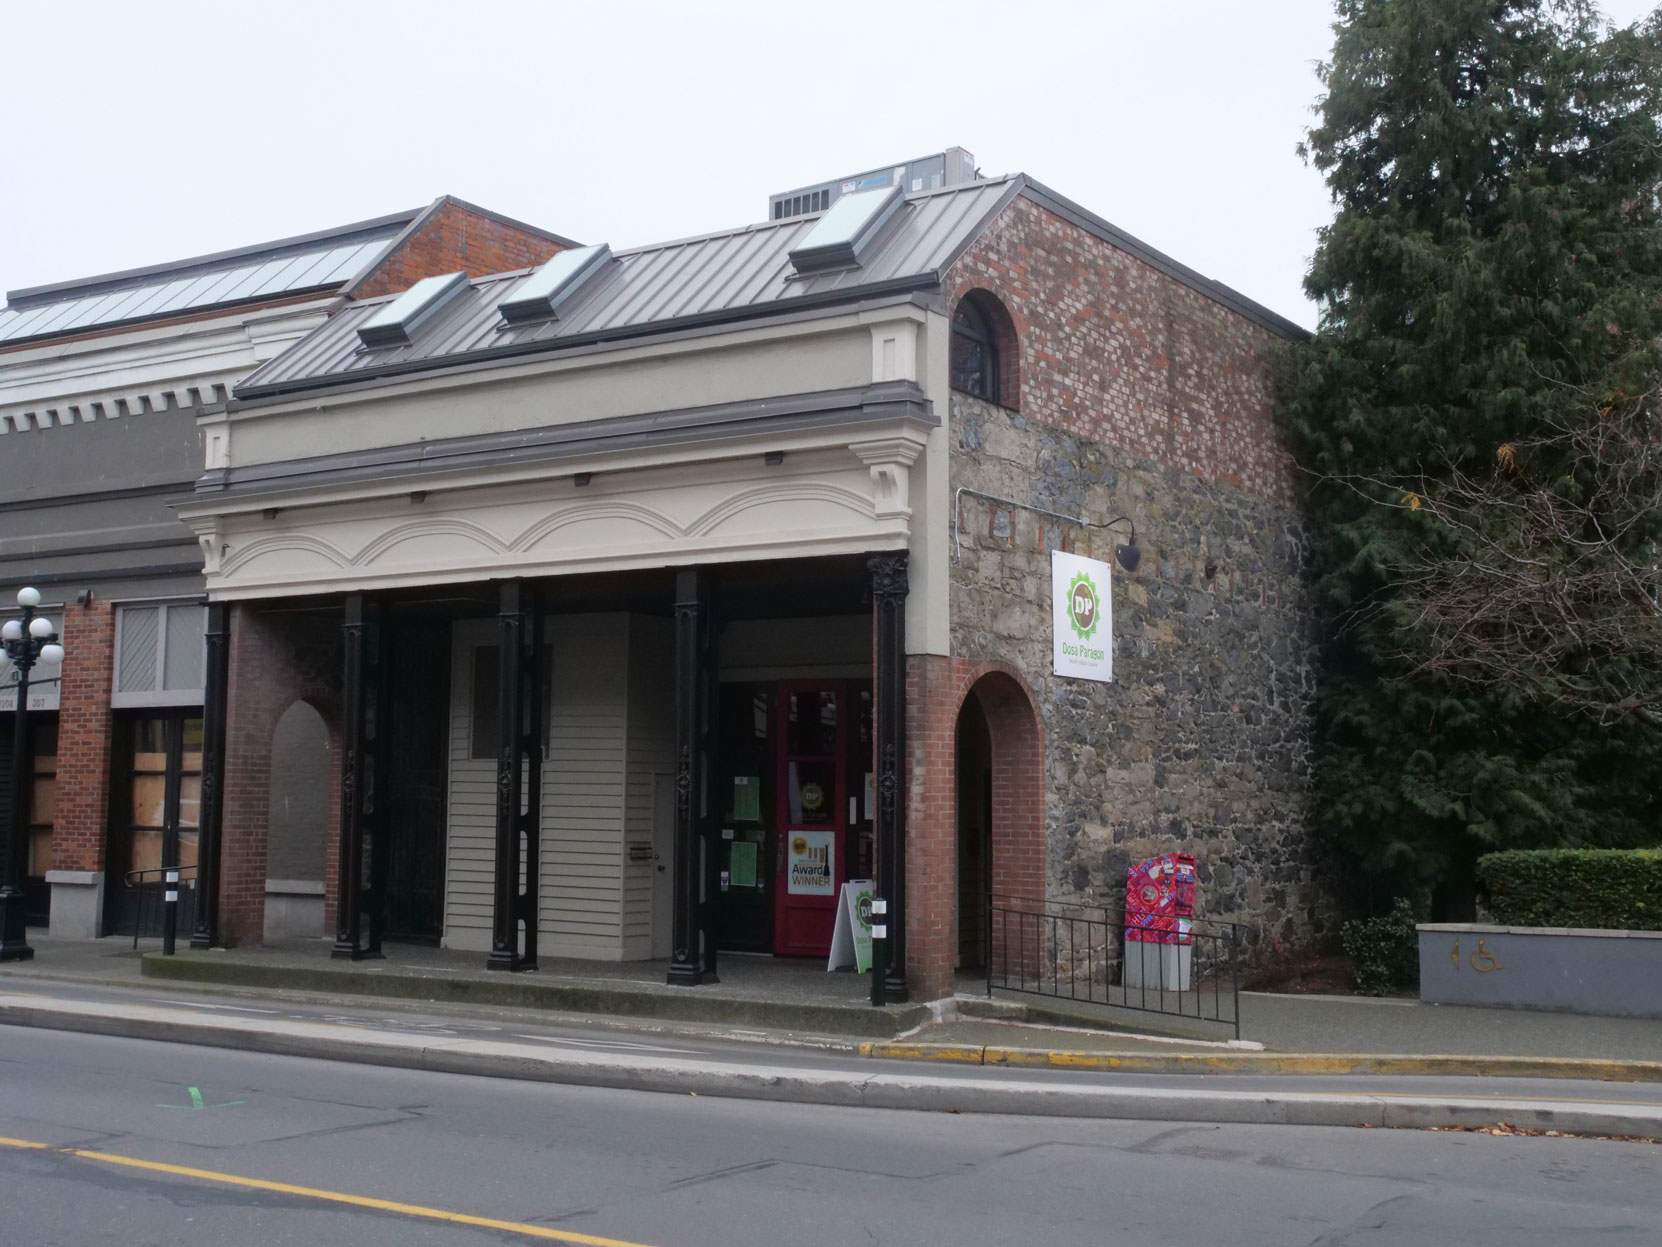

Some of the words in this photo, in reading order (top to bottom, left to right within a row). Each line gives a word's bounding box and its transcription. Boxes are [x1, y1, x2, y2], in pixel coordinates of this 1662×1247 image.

[1075, 596, 1092, 615] DP
[1062, 641, 1078, 657] Dosa
[1079, 644, 1105, 661] Paragon
[792, 863, 824, 875] Award
[792, 875, 831, 887] WINNER
